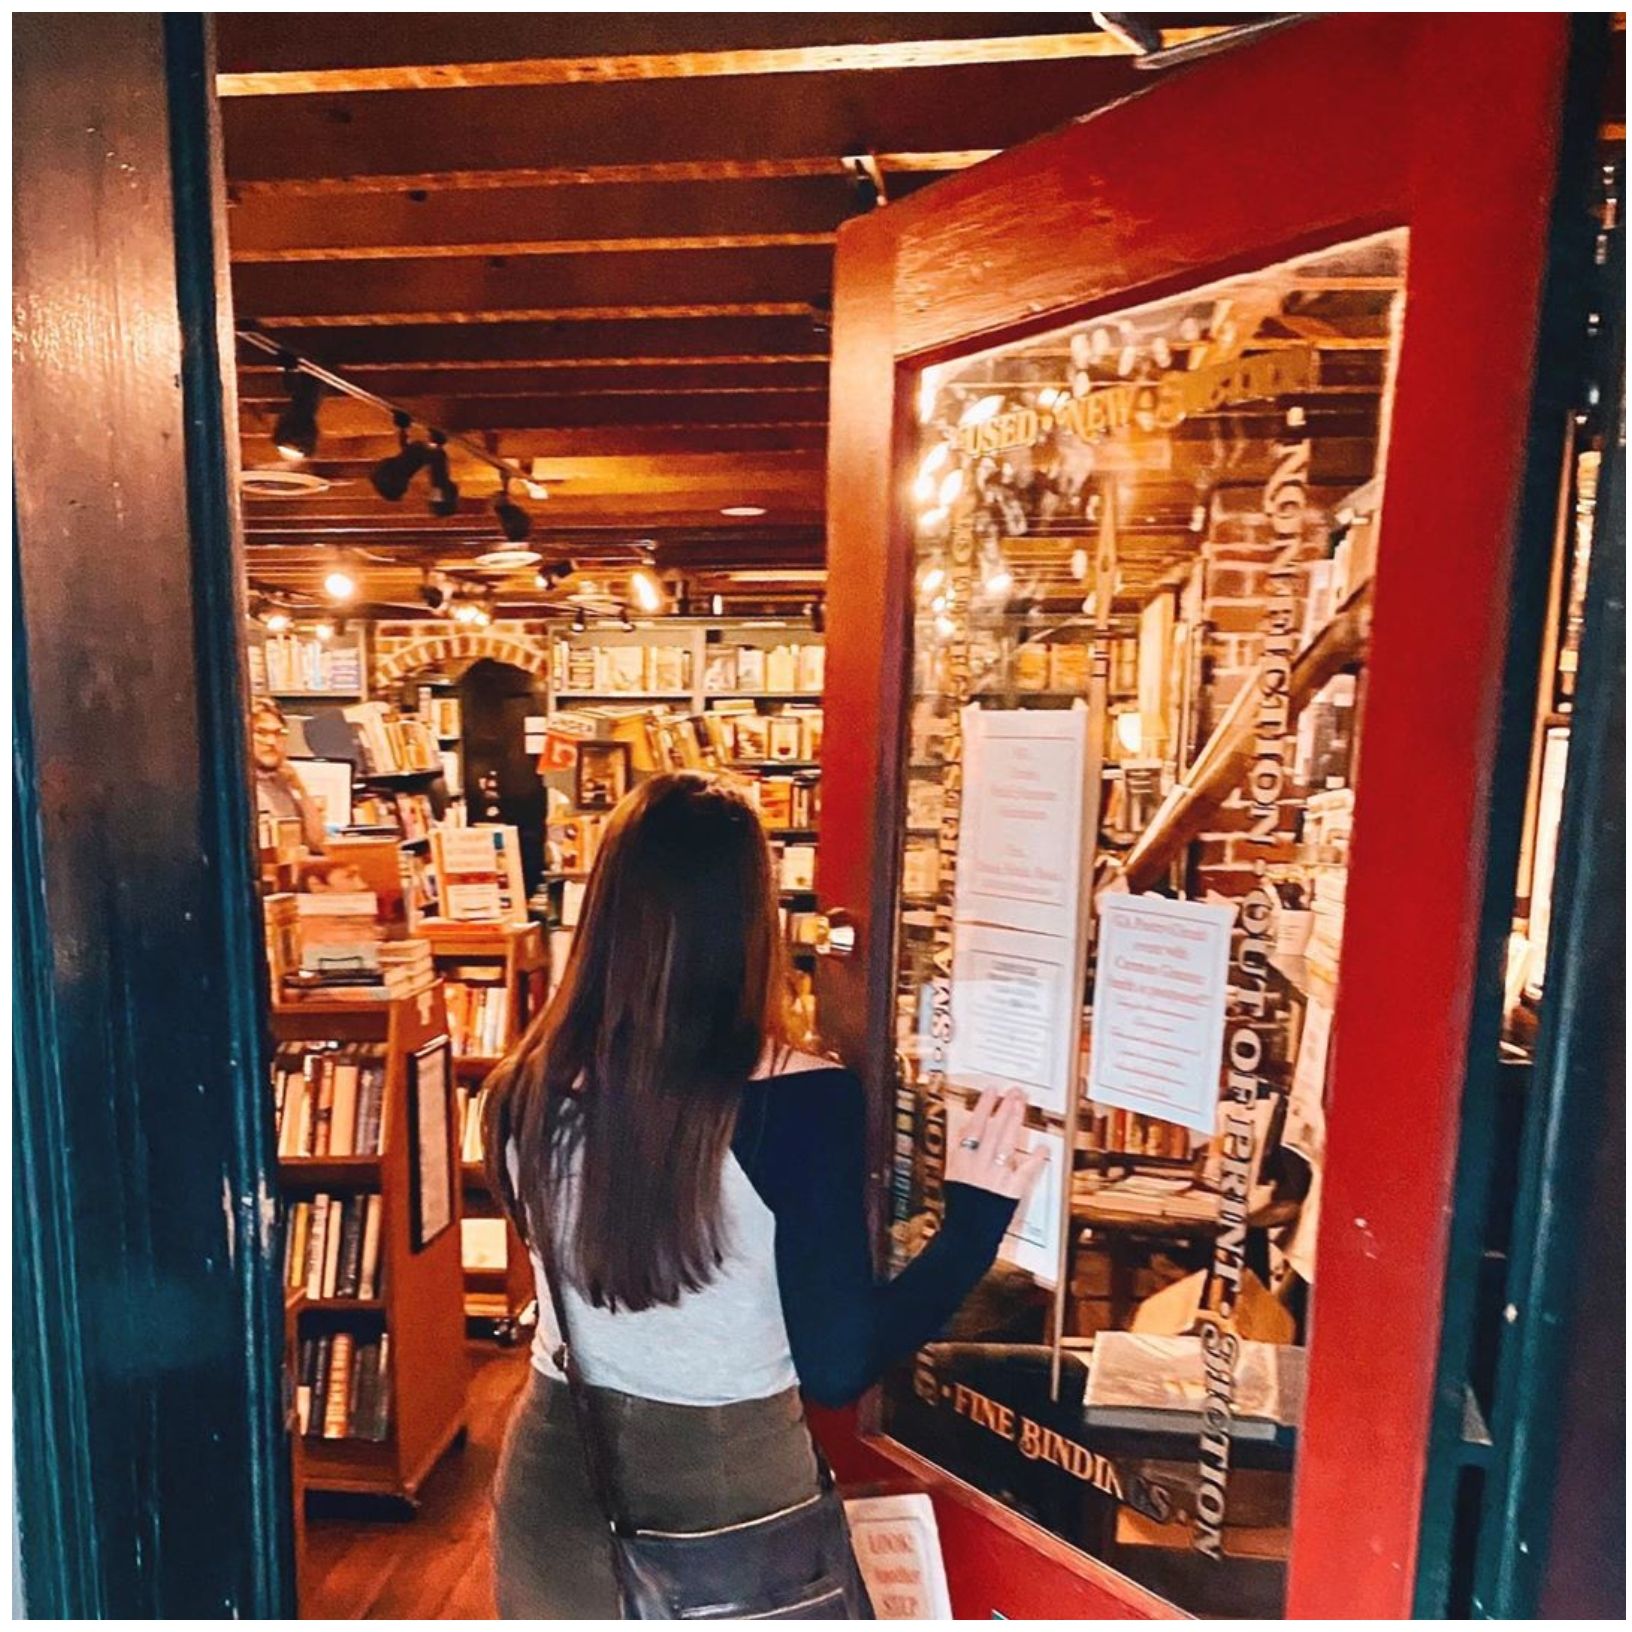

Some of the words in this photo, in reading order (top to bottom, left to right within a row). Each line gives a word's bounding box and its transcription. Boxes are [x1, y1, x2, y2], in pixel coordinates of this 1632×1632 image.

[957, 409, 1038, 456] USED
[1263, 441, 1311, 580] NON
[1248, 596, 1302, 845] FICTION
[1236, 890, 1275, 1017] OUT
[1228, 1027, 1264, 1110] OF
[1214, 1117, 1255, 1292] PRINT
[953, 1381, 1016, 1443] FINE
[1191, 1322, 1241, 1562] FICTION
